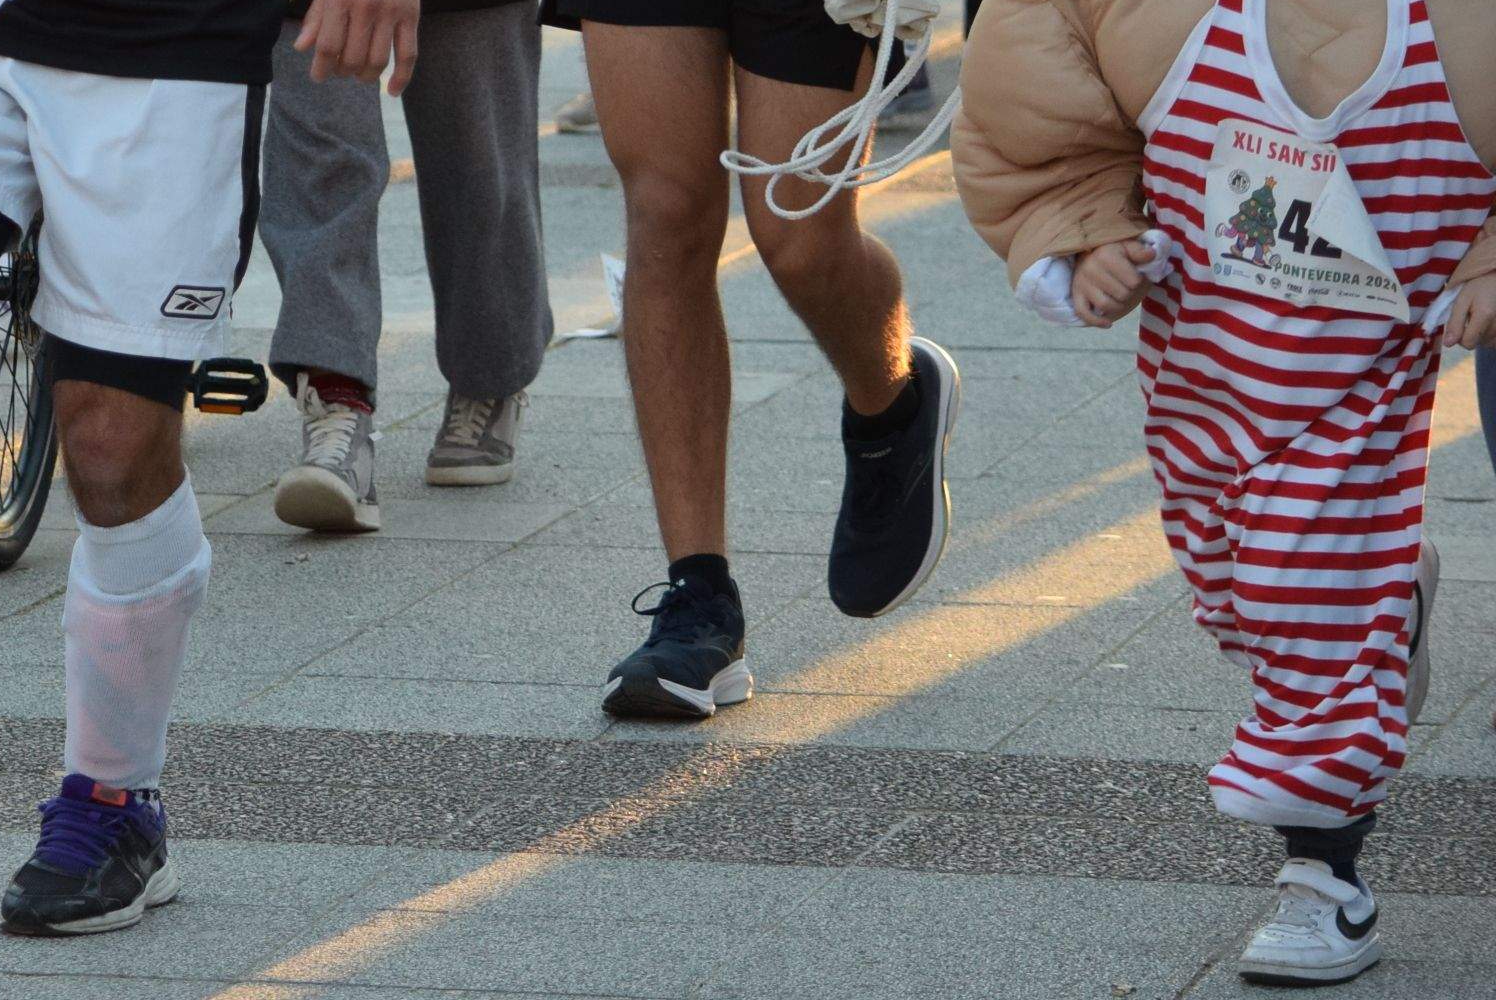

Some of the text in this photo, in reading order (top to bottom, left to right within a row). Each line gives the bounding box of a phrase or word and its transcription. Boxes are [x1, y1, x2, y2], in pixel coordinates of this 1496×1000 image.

[1233, 131, 1262, 154] XLI
[1267, 142, 1304, 168] SAN
[1273, 263, 1359, 285] PONTEVEDRA
[1366, 275, 1397, 293] 2024
